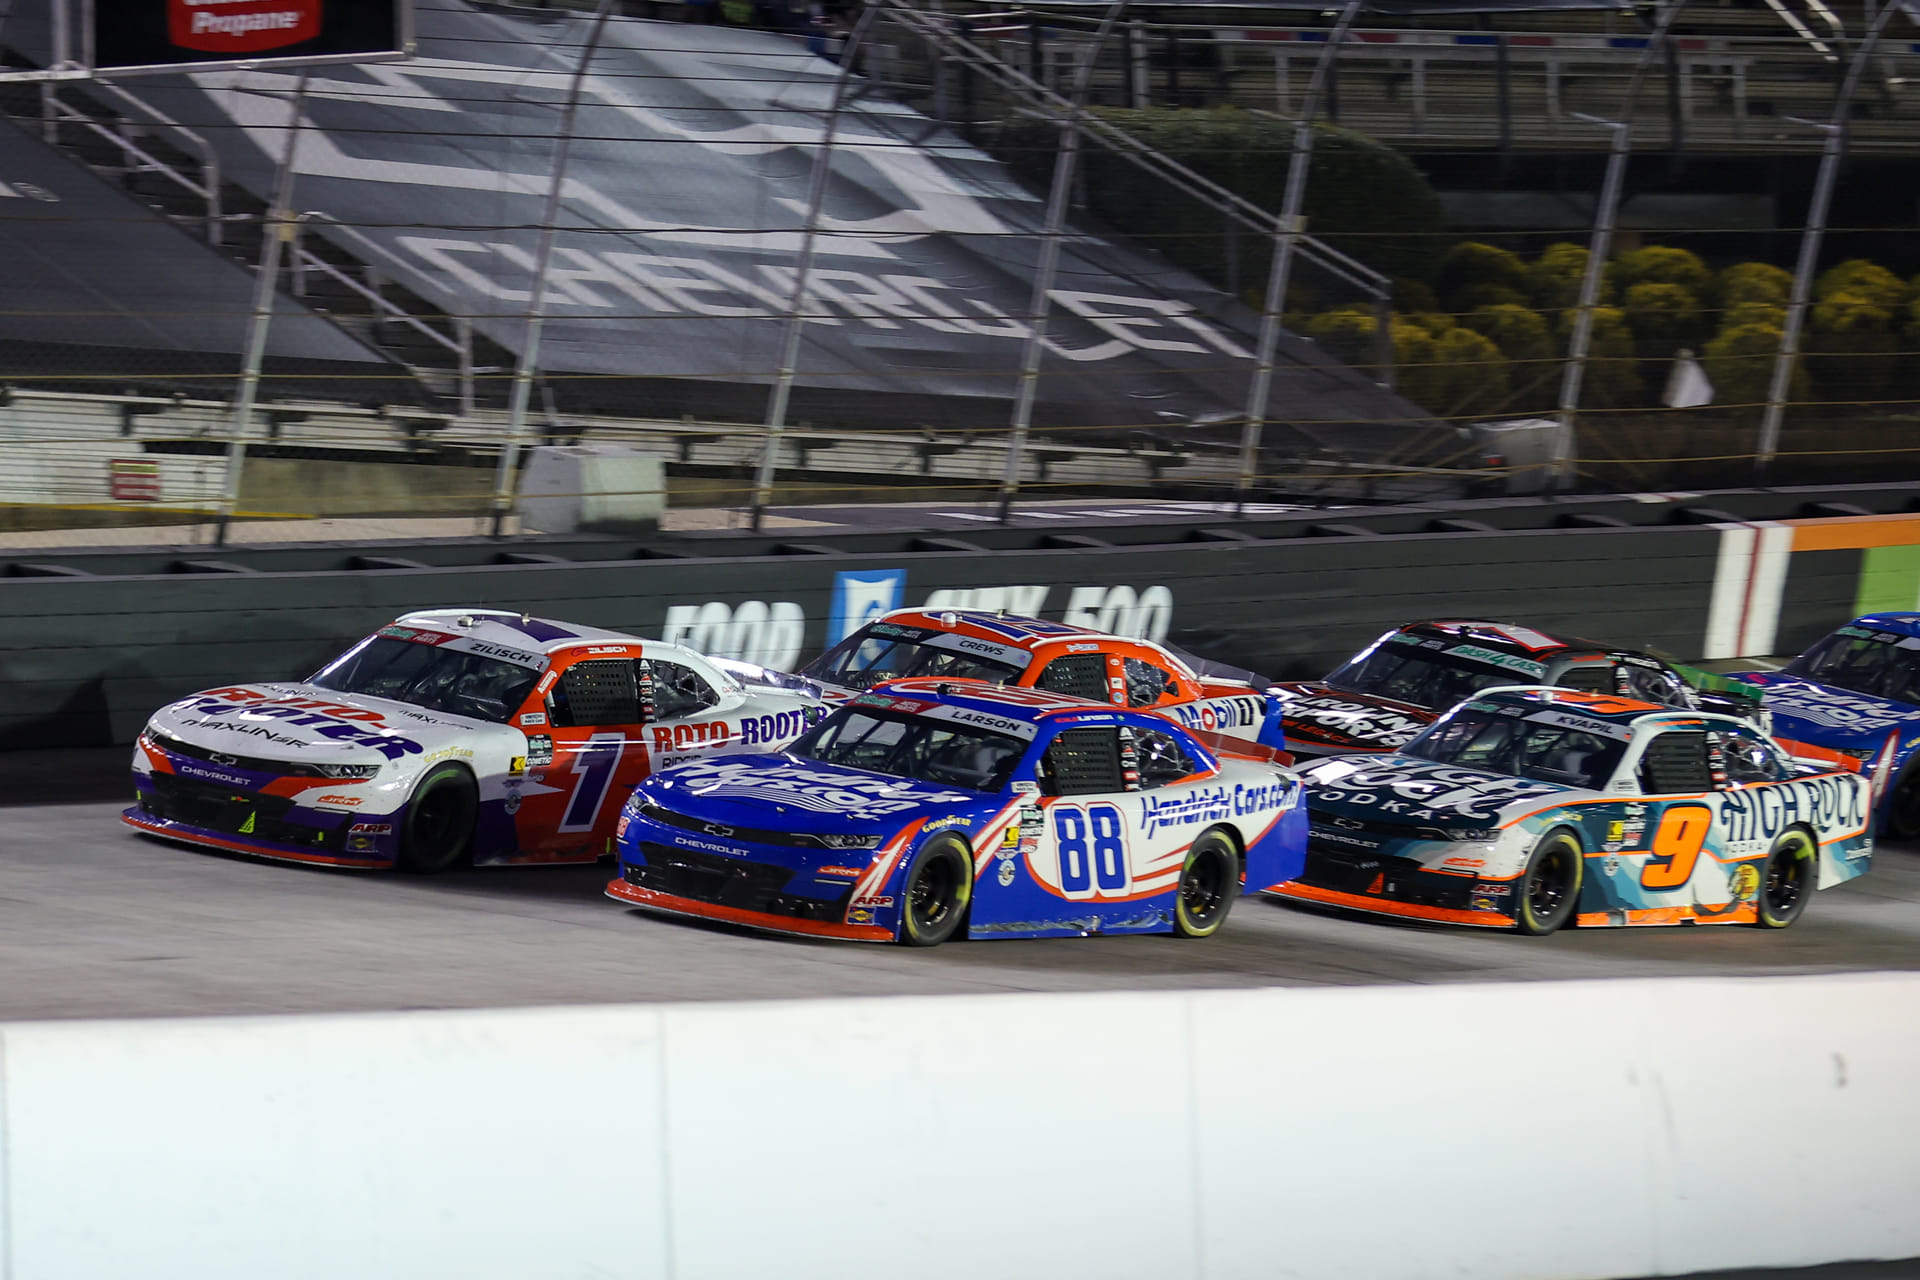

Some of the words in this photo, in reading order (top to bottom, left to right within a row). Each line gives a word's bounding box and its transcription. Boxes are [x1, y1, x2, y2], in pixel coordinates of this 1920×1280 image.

[191, 11, 301, 37] Propane
[470, 642, 533, 663] ZILISCH
[959, 639, 1006, 656] CREWS
[951, 710, 1022, 732] LARSON
[1175, 699, 1237, 731] Mobil
[1235, 697, 1254, 727] 1
[1556, 715, 1614, 735] KVAPIL
[180, 765, 252, 786] CHEVROLET
[557, 732, 626, 833] 1
[1140, 785, 1233, 840] Hendrick
[1720, 785, 1799, 843] HIGH
[350, 823, 392, 834] ARP
[674, 836, 751, 857] CHEVROLET
[1053, 806, 1127, 893] 88
[1640, 804, 1713, 890] 9
[1474, 884, 1511, 895] ARP
[853, 896, 894, 906] ARP
